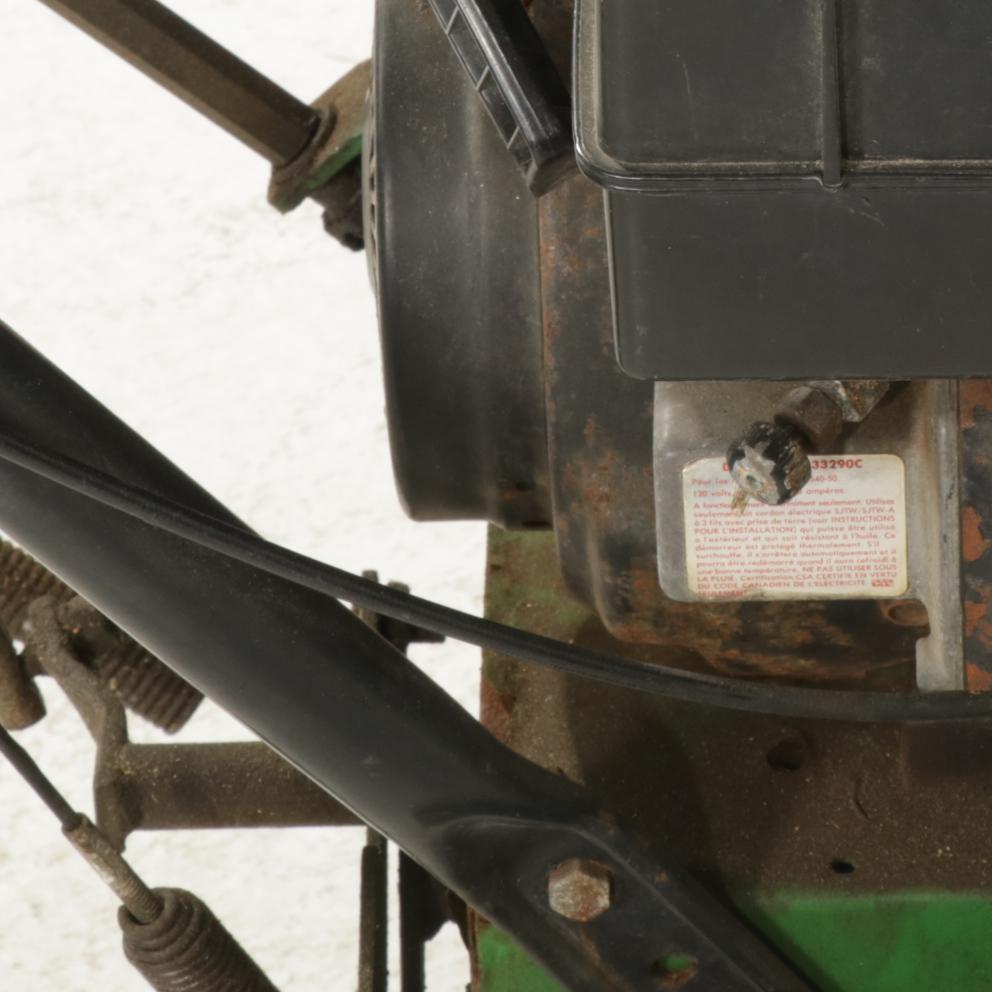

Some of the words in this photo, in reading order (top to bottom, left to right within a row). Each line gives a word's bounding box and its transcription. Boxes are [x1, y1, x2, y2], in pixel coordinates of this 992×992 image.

[831, 515, 896, 523] INSTRUCTIONS
[694, 527, 720, 535] POUR
[742, 581, 791, 589] CANADIEN
